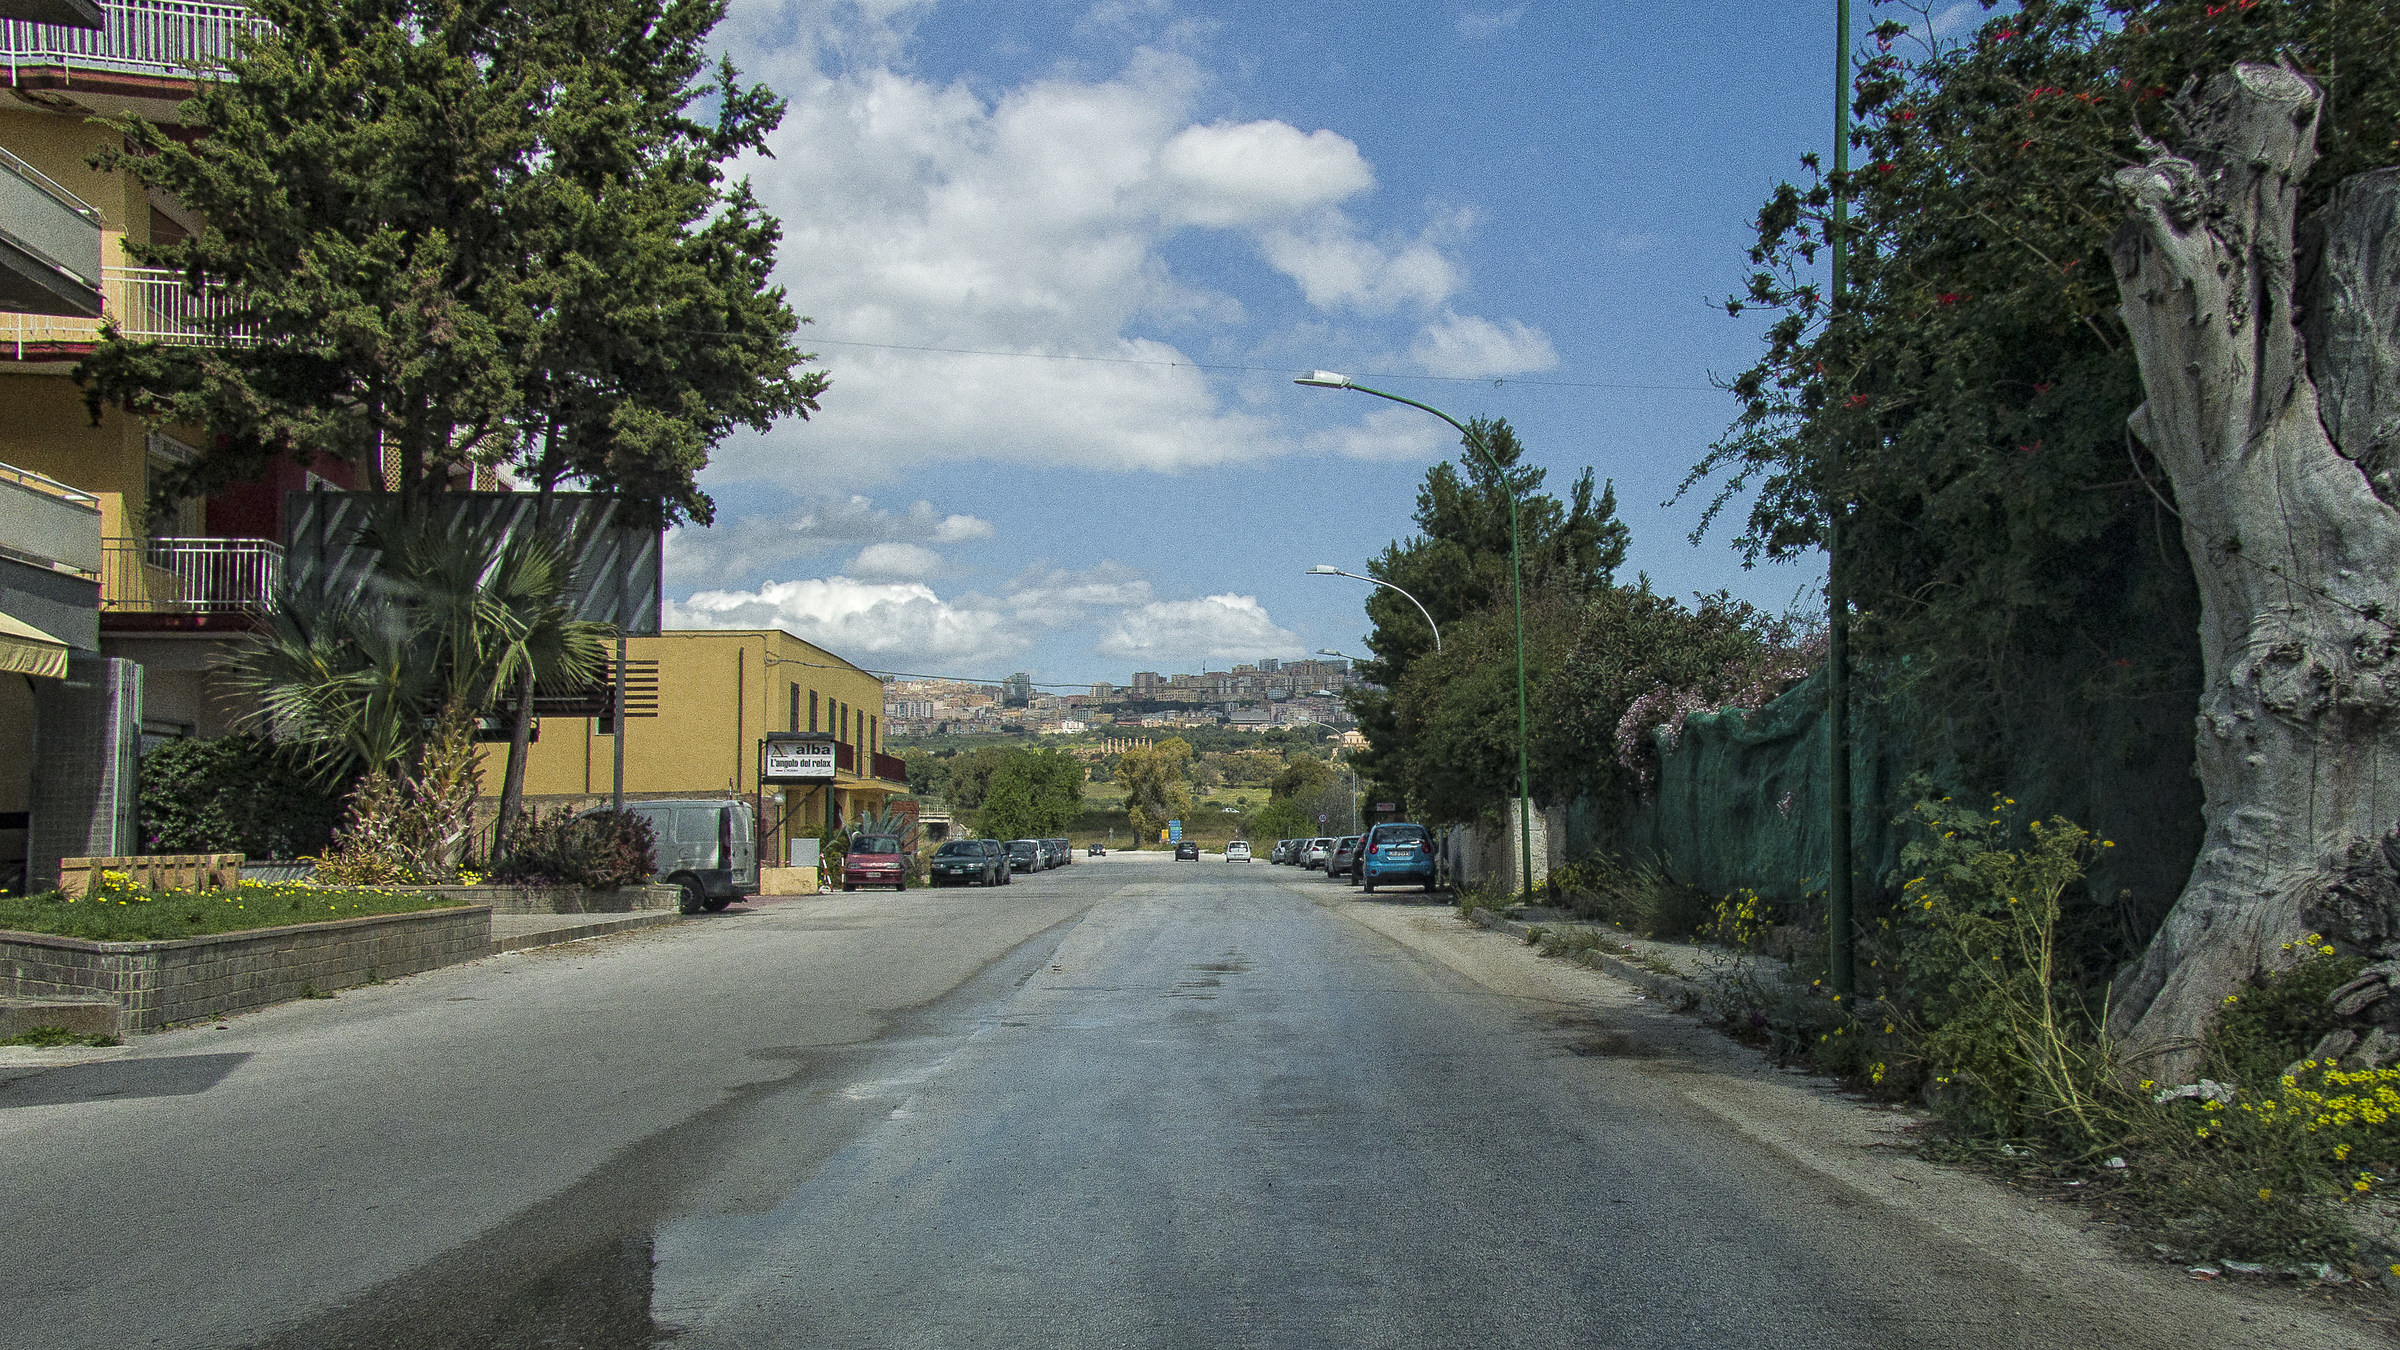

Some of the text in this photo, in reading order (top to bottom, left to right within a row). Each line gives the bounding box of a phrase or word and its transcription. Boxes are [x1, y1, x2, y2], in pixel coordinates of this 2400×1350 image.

[796, 744, 830, 754] alba
[770, 759, 831, 768] L'angolo del relax
